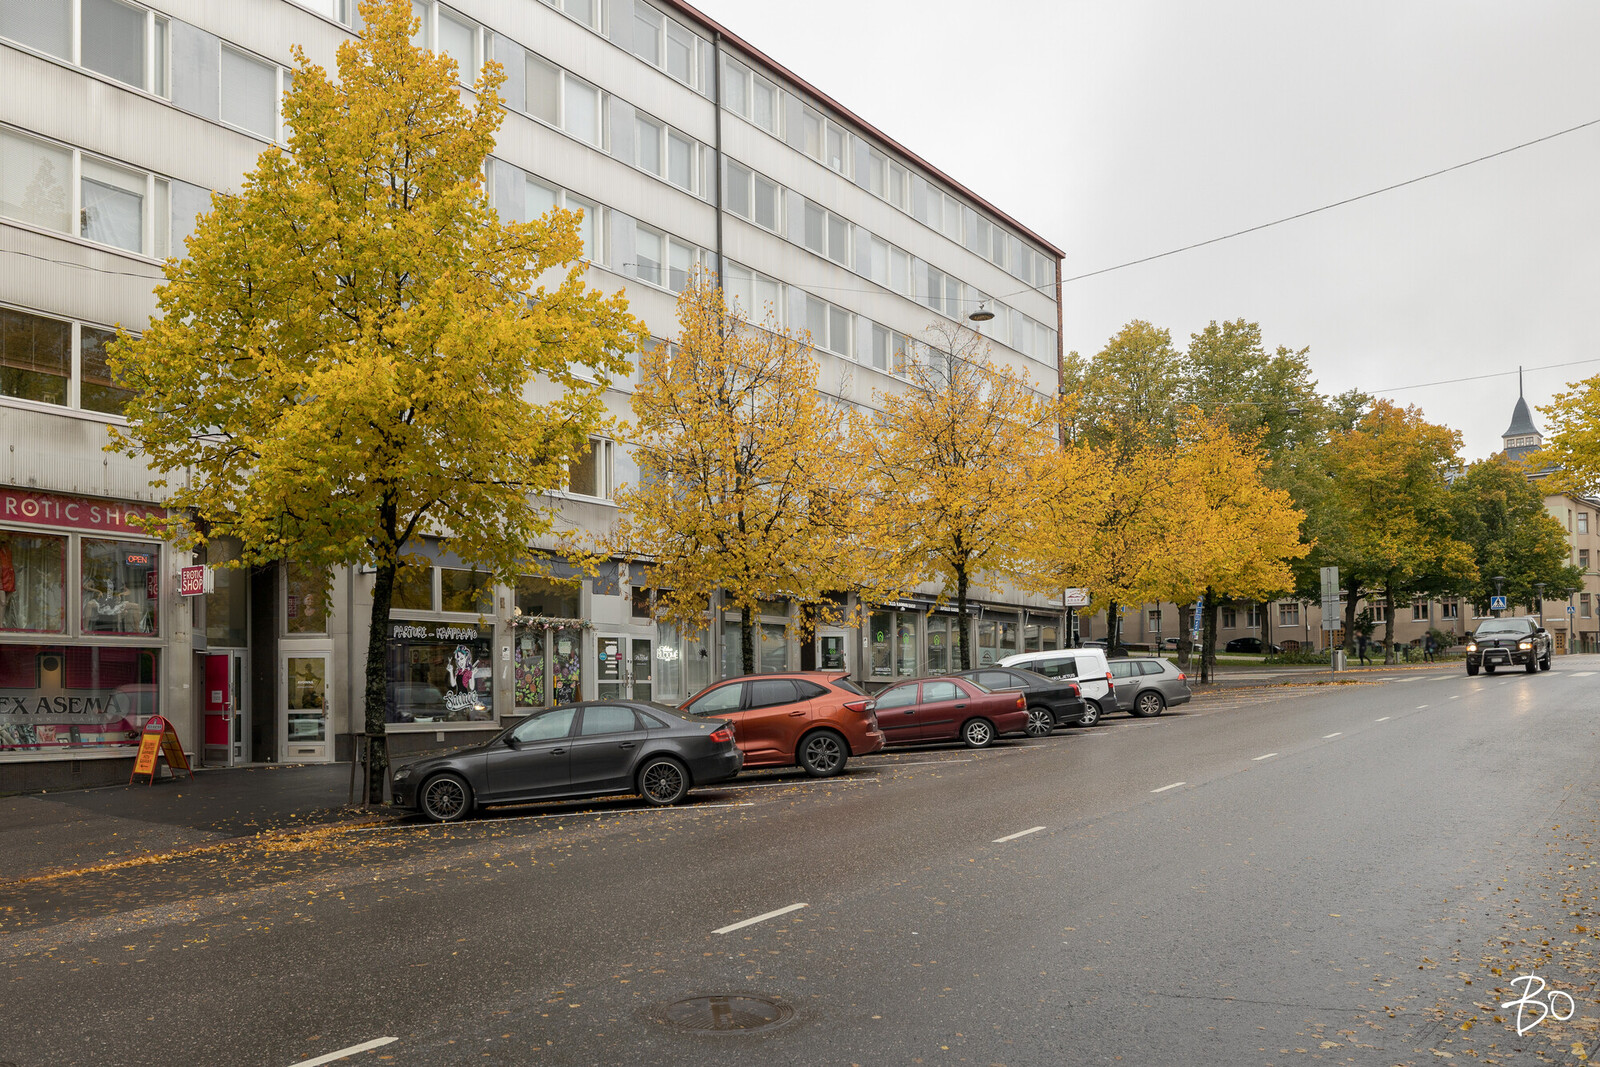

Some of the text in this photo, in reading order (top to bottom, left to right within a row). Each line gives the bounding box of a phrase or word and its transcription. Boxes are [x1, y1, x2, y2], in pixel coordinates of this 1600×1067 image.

[6, 497, 154, 527] ROTIC SHO
[128, 555, 147, 563] OPEN
[183, 569, 203, 580] EROTIC
[183, 579, 203, 591] SHOP
[393, 625, 427, 639] PARTURI
[435, 626, 478, 640] KAMPAAMO
[0, 694, 122, 714] EX ASEMA
